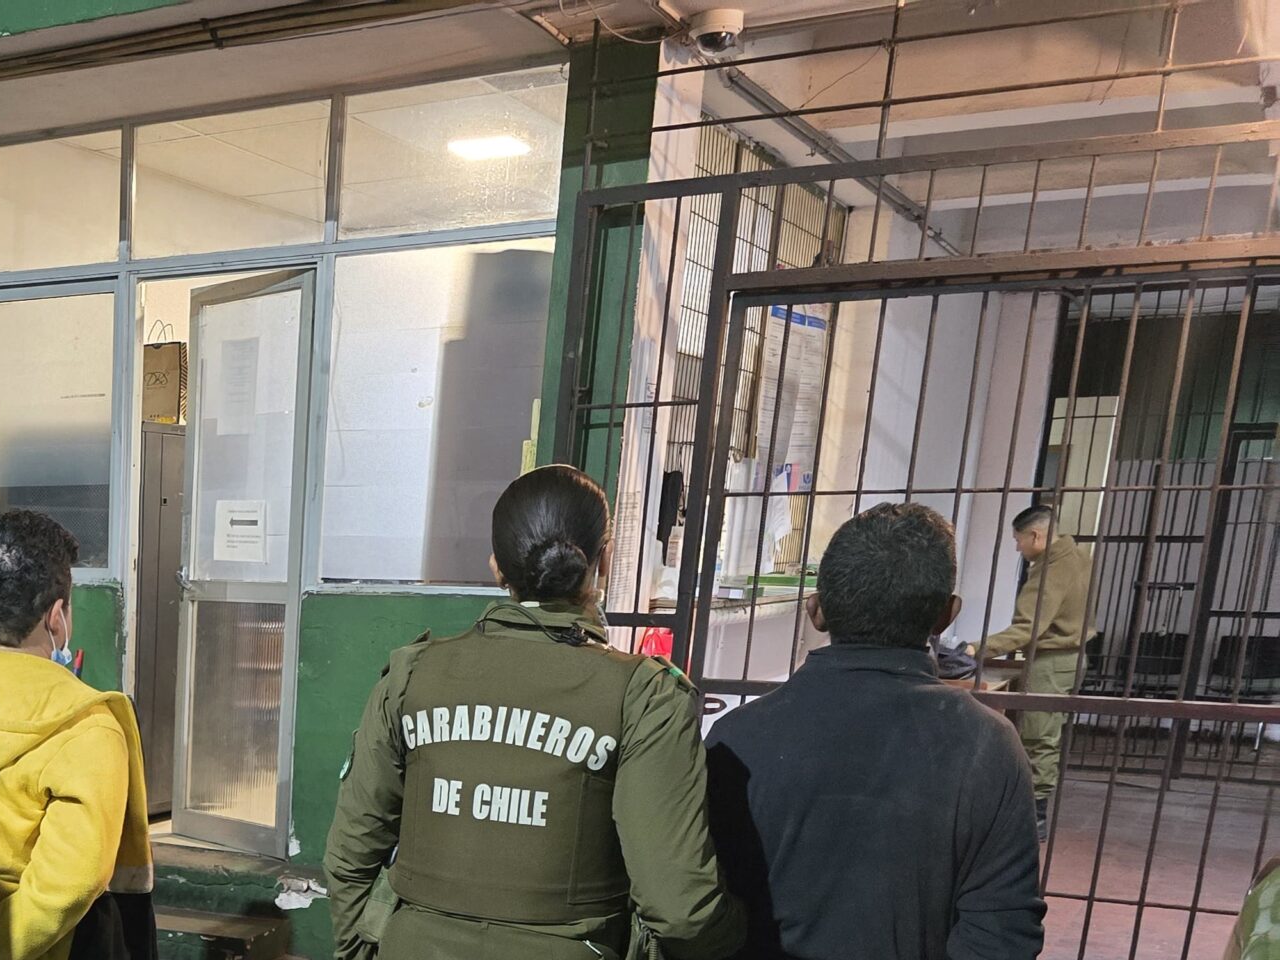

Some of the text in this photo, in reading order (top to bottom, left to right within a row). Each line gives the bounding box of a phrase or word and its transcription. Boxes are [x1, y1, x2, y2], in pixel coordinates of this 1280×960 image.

[401, 704, 618, 771] CARABINEROS
[432, 777, 549, 827] DE CHILE
